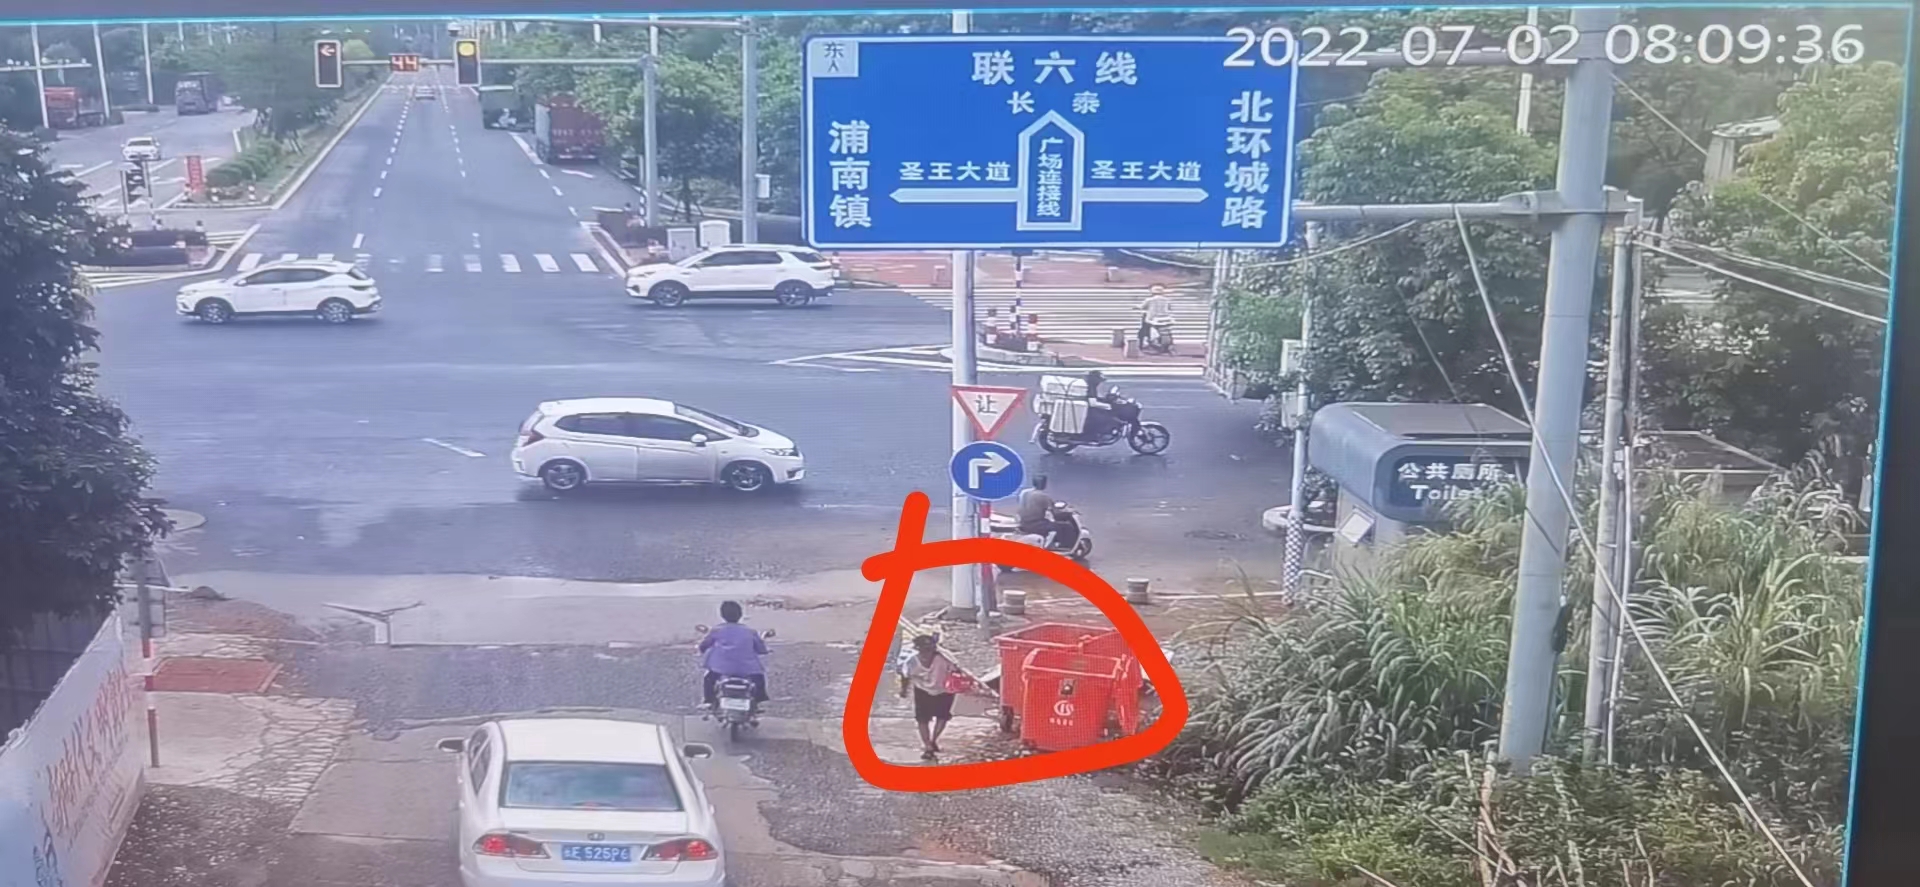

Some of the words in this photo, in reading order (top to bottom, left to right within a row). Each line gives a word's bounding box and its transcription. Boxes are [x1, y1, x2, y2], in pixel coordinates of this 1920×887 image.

[391, 55, 417, 71] 44
[971, 50, 1139, 87] 联六线
[1006, 91, 1101, 115] 长泰
[1090, 160, 1203, 181] 圣王大道
[1221, 90, 1274, 230] 北环城路
[828, 120, 872, 229] 浦南镇
[899, 161, 1012, 182] 圣王大道
[1036, 136, 1062, 218] 广场连接线
[975, 394, 998, 415] 让
[1397, 462, 1503, 481] 公共厕所
